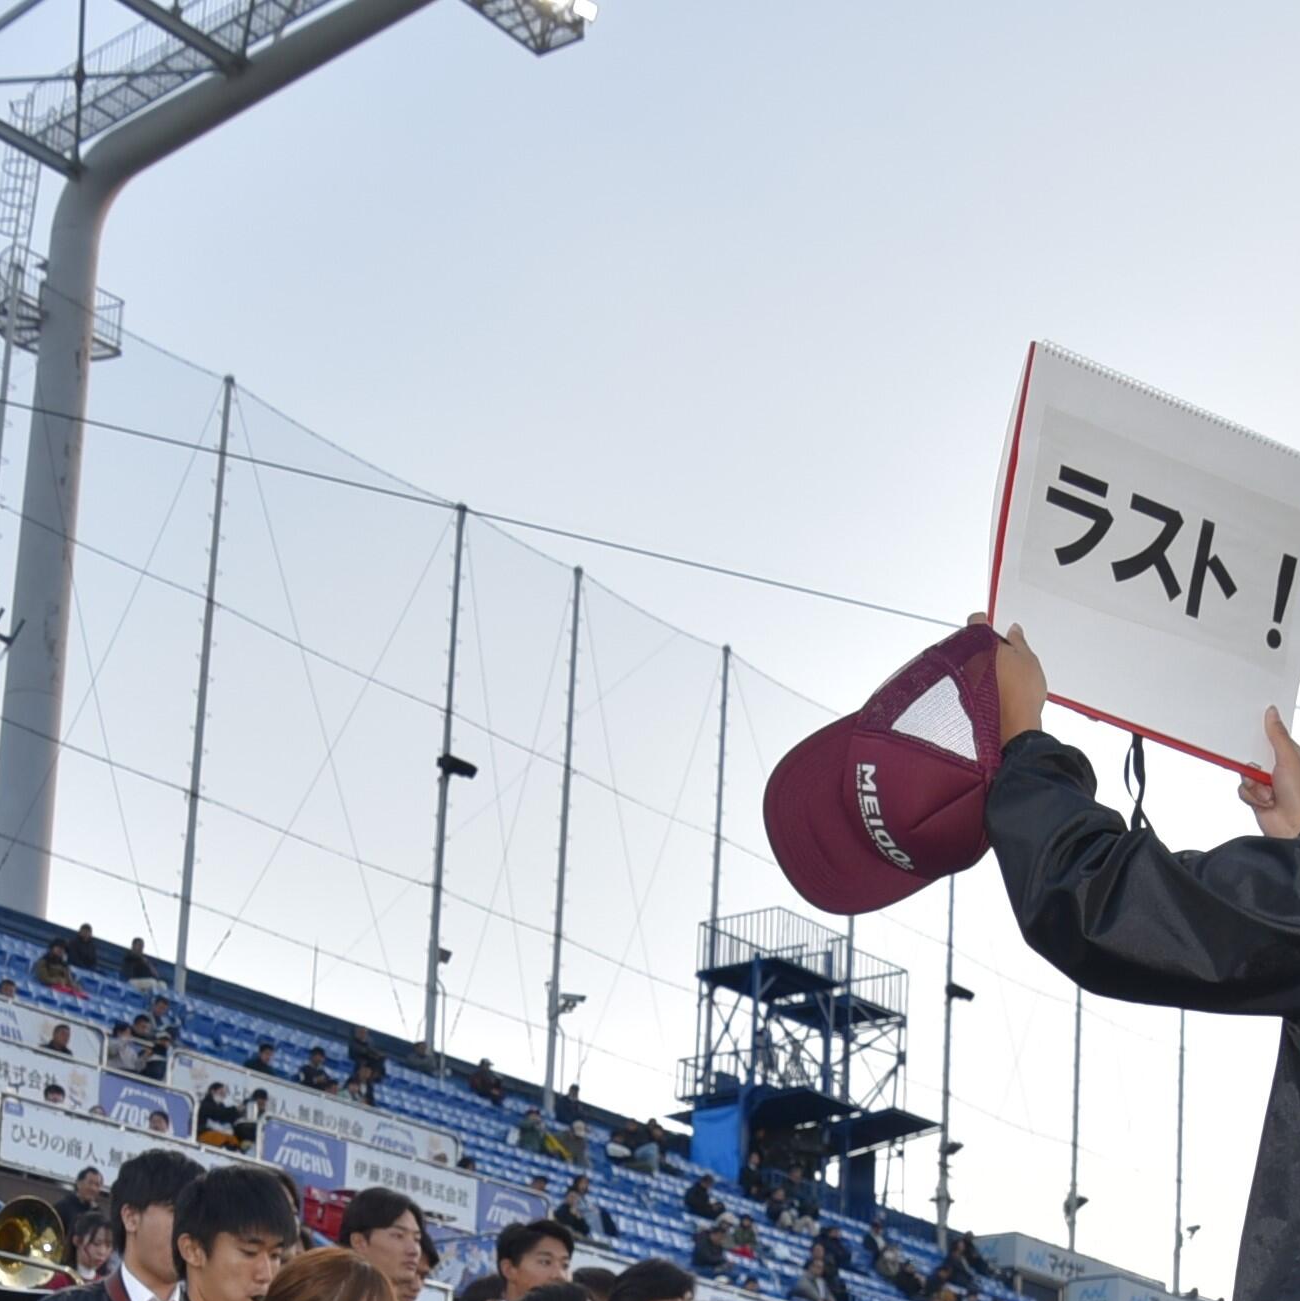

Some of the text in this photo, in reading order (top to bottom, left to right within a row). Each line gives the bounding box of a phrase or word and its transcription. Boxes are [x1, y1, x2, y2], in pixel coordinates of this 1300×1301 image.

[1046, 464, 1298, 650] ラスト！
[10, 1122, 133, 1169] ひとりの商人、無
[273, 1145, 334, 1179] ITOCHU
[354, 1158, 470, 1209] 伊藤忠商事株式会社
[1048, 1253, 1086, 1277] マイナビ
